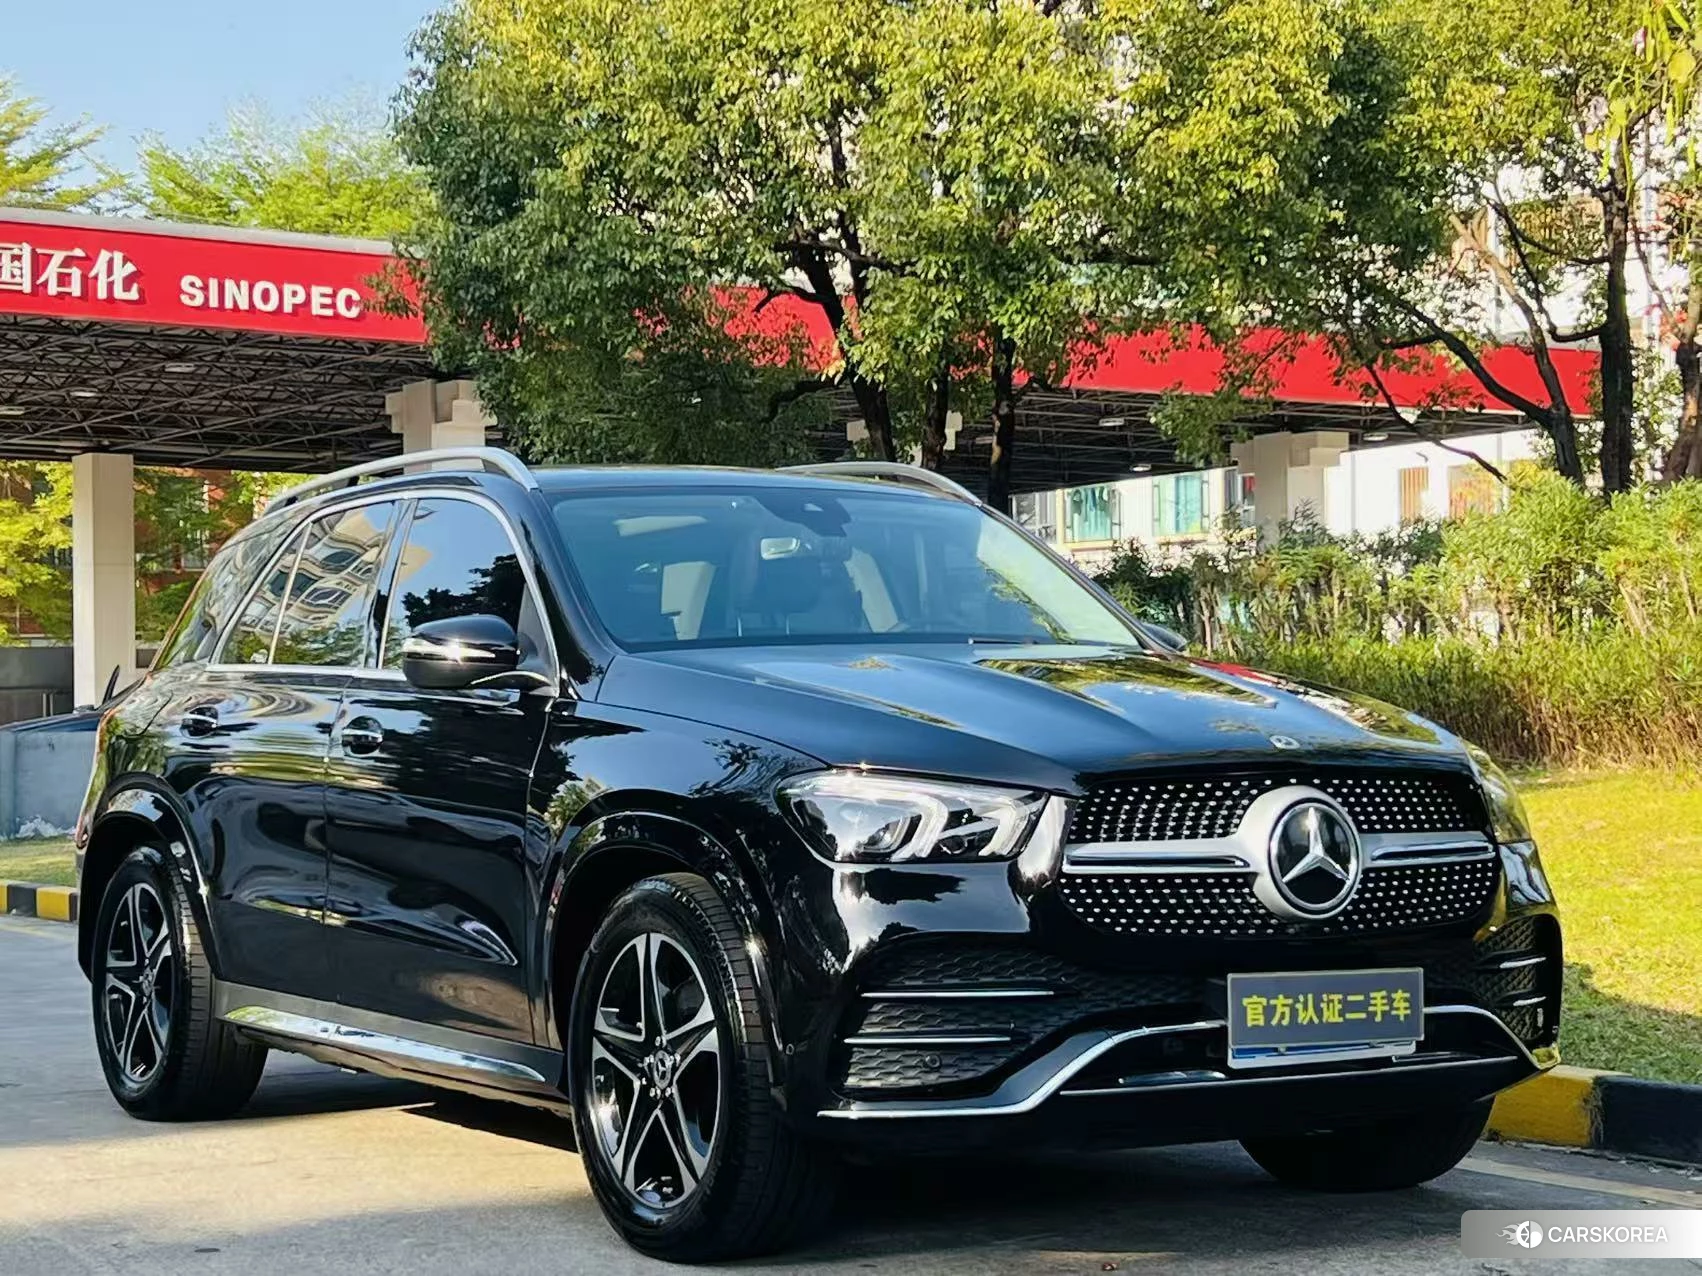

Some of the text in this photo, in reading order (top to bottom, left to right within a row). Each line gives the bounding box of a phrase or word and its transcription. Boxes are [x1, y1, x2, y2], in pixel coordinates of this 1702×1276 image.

[179, 274, 362, 319] SINOPEC
[1242, 989, 1411, 1027] 官方认证二手车
